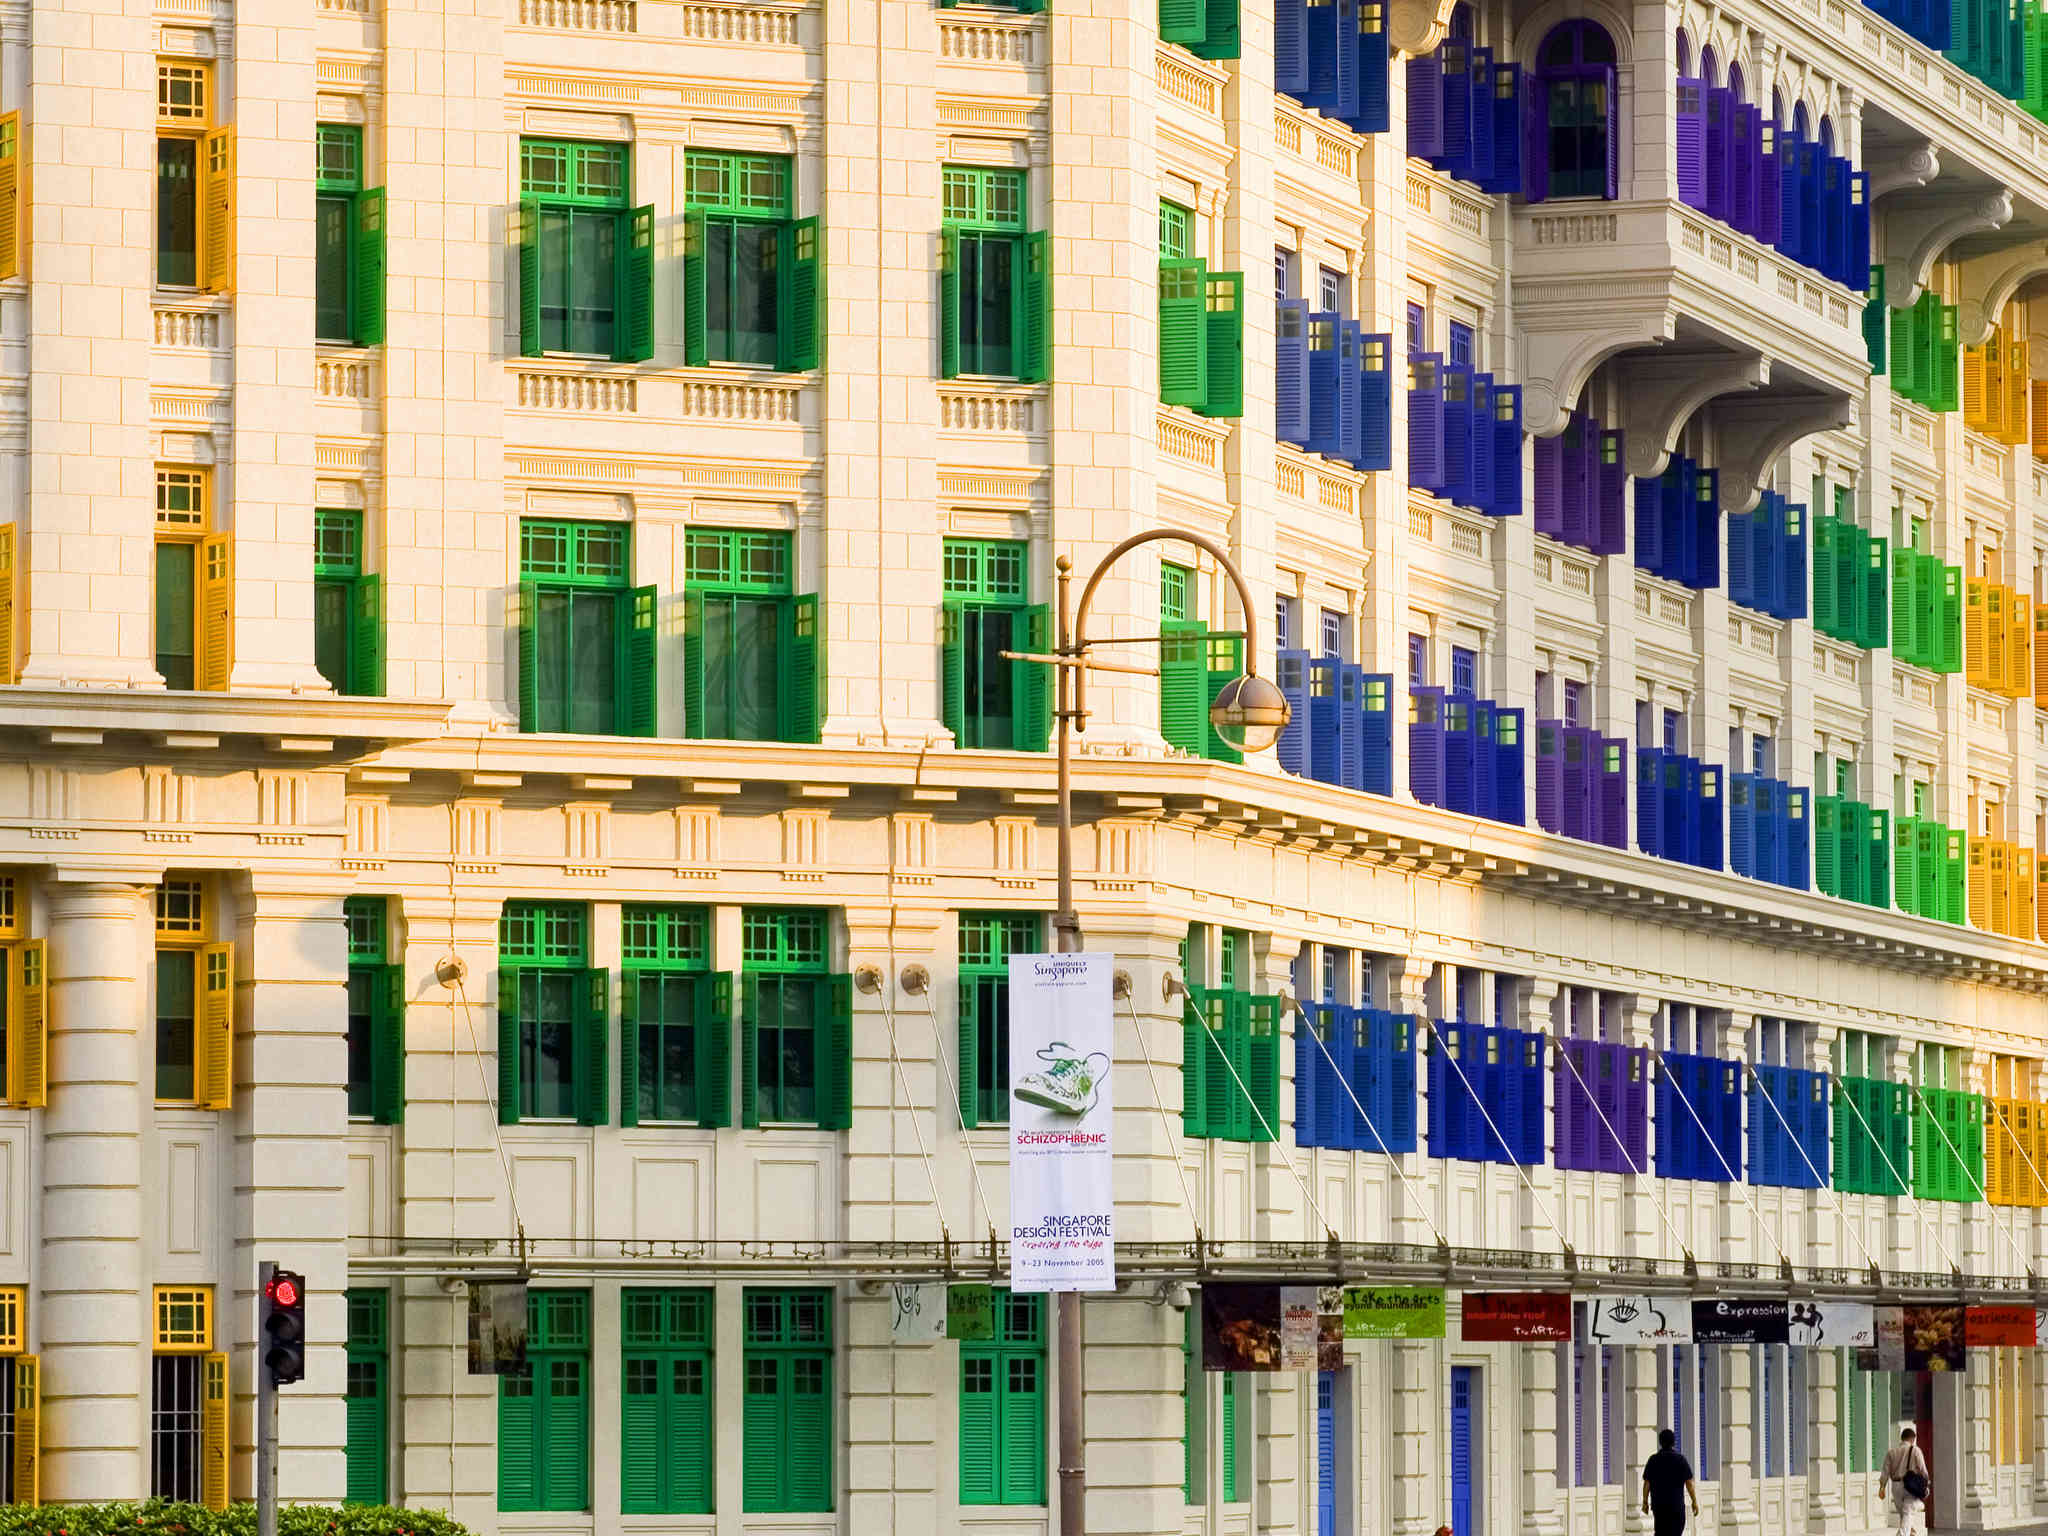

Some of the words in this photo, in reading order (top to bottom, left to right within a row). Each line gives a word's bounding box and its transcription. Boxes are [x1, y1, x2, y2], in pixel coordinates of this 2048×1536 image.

[1034, 962, 1088, 981] Singapore
[1017, 1133, 1106, 1144] SCHIZOPHRENIC
[1043, 1215, 1111, 1226] SINGAPORE
[1013, 1227, 1057, 1238] DESIGN
[1059, 1226, 1111, 1237] FESTIVAL
[1044, 1259, 1083, 1267] November
